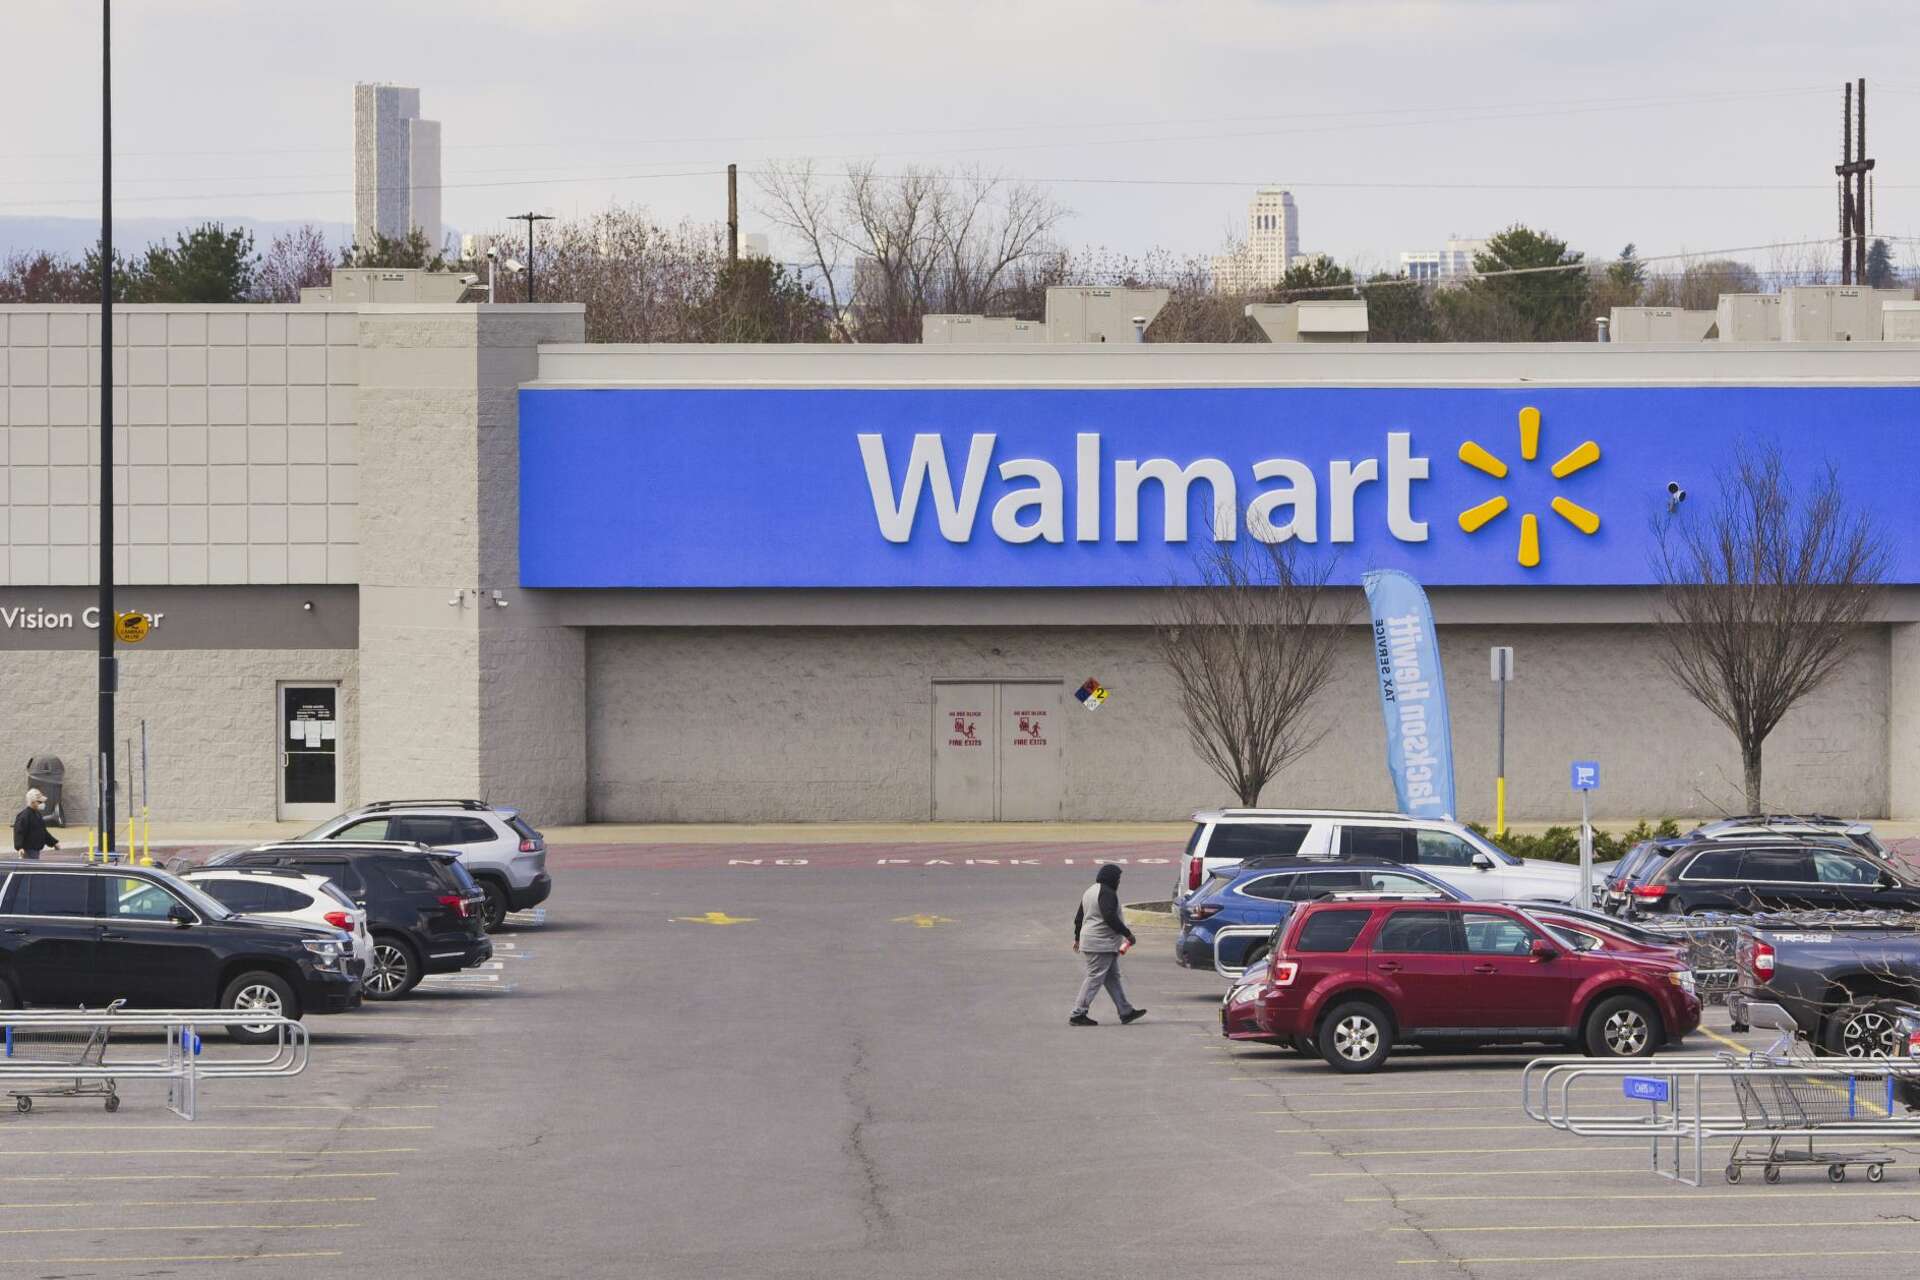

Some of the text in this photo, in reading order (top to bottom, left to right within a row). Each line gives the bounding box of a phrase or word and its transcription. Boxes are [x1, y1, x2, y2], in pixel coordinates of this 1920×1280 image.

[857, 432, 1430, 543] Walmart
[0, 607, 73, 628] Vision
[1096, 687, 1105, 698] 2
